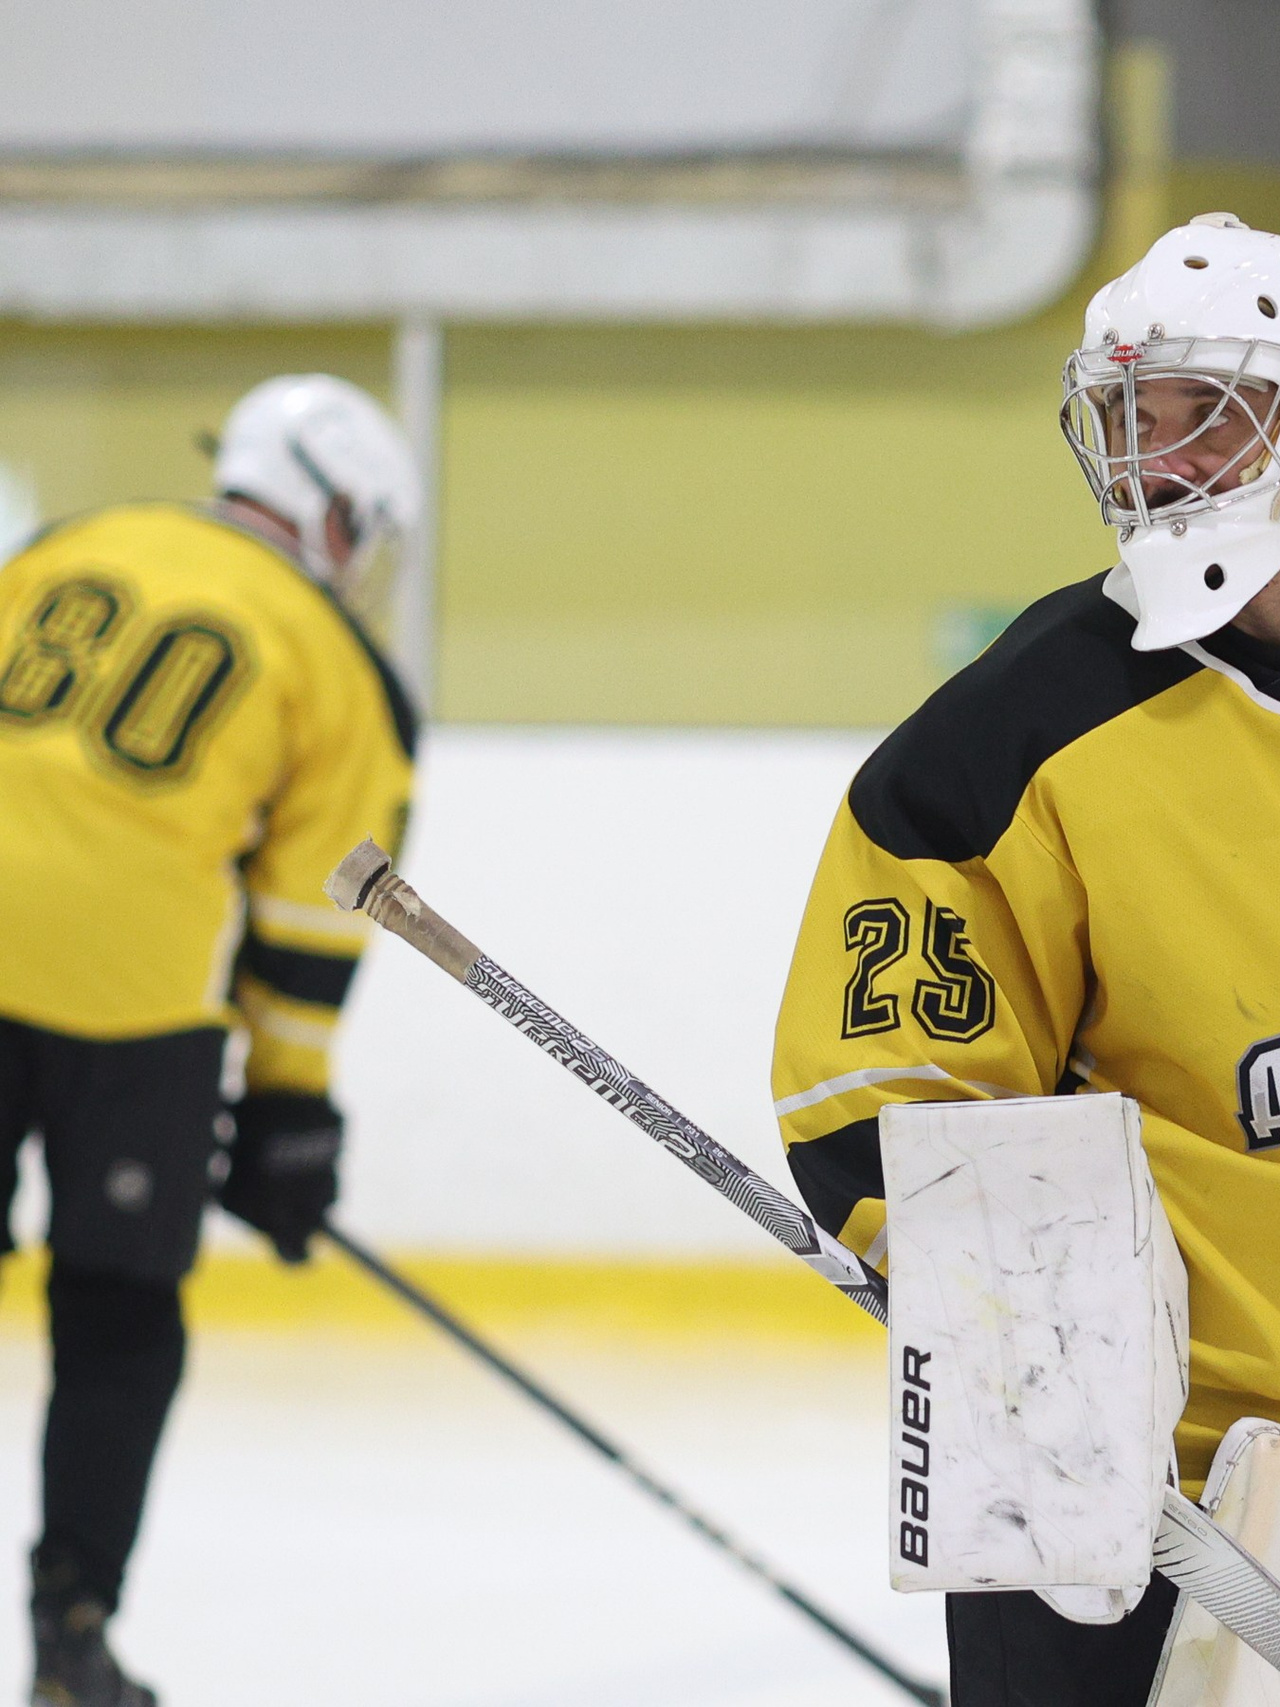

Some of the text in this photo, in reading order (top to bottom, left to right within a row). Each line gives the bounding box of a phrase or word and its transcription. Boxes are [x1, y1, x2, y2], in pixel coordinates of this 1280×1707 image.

[0, 576, 251, 780] 80
[840, 895, 995, 1044] 25
[645, 1092, 673, 1116] SENIOR
[900, 1345, 931, 1567] BAUER
